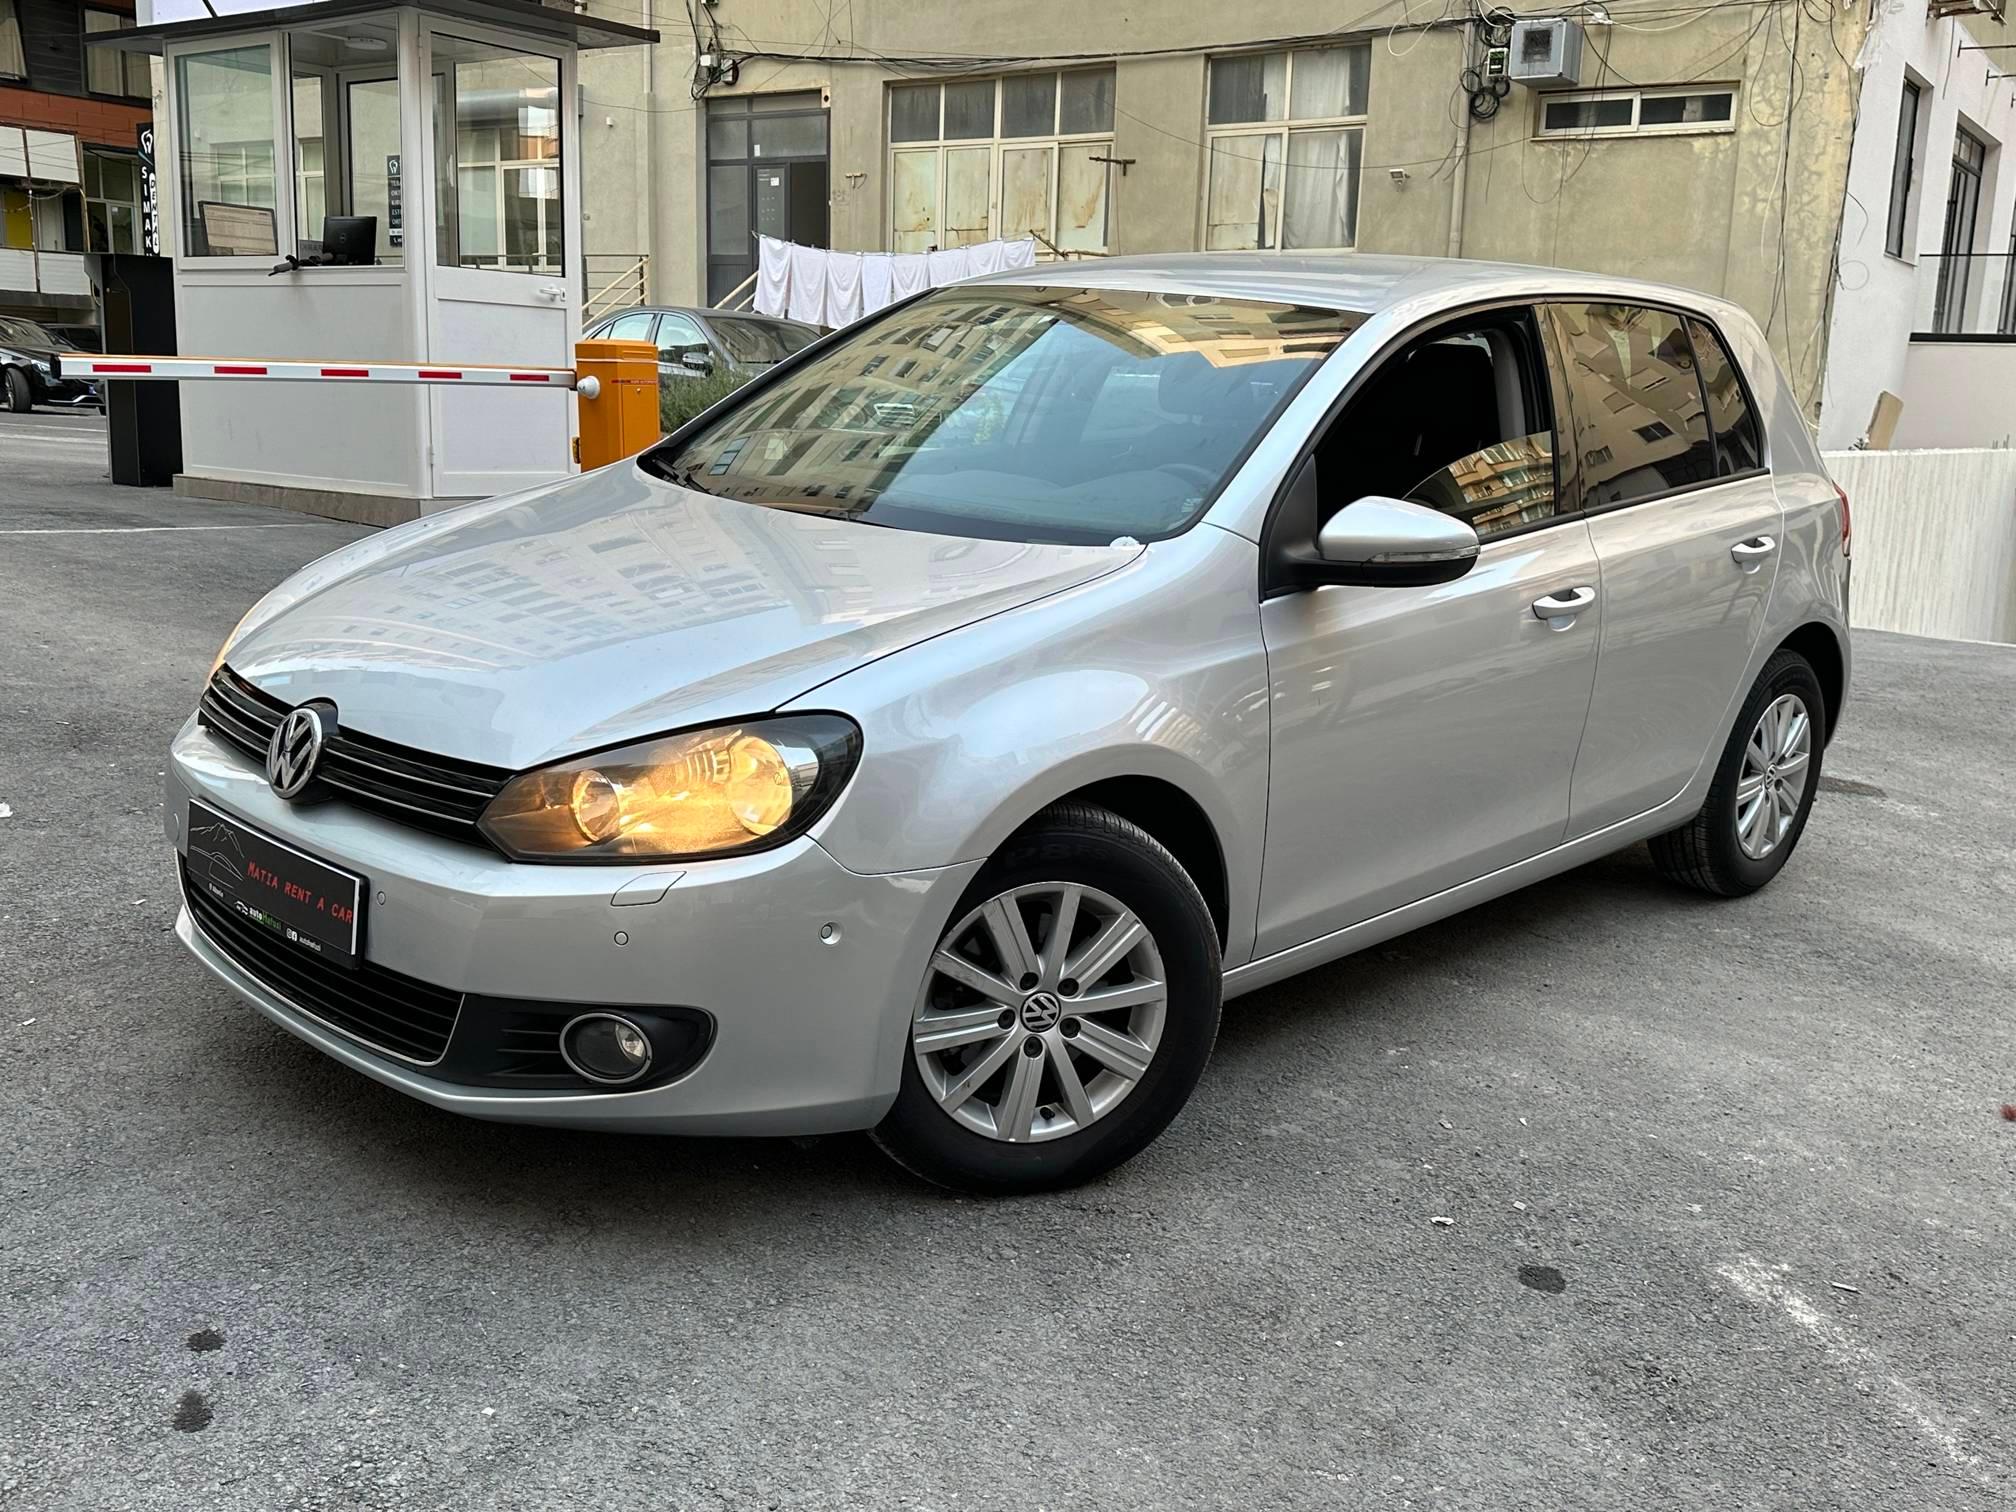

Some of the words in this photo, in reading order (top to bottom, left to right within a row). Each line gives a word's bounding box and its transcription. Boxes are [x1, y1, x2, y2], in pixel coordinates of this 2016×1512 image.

[150, 180, 159, 246] DENTAL
[247, 861, 278, 891] MATIA
[284, 881, 312, 904] RENT
[317, 897, 325, 911] A
[331, 903, 353, 924] CAR
